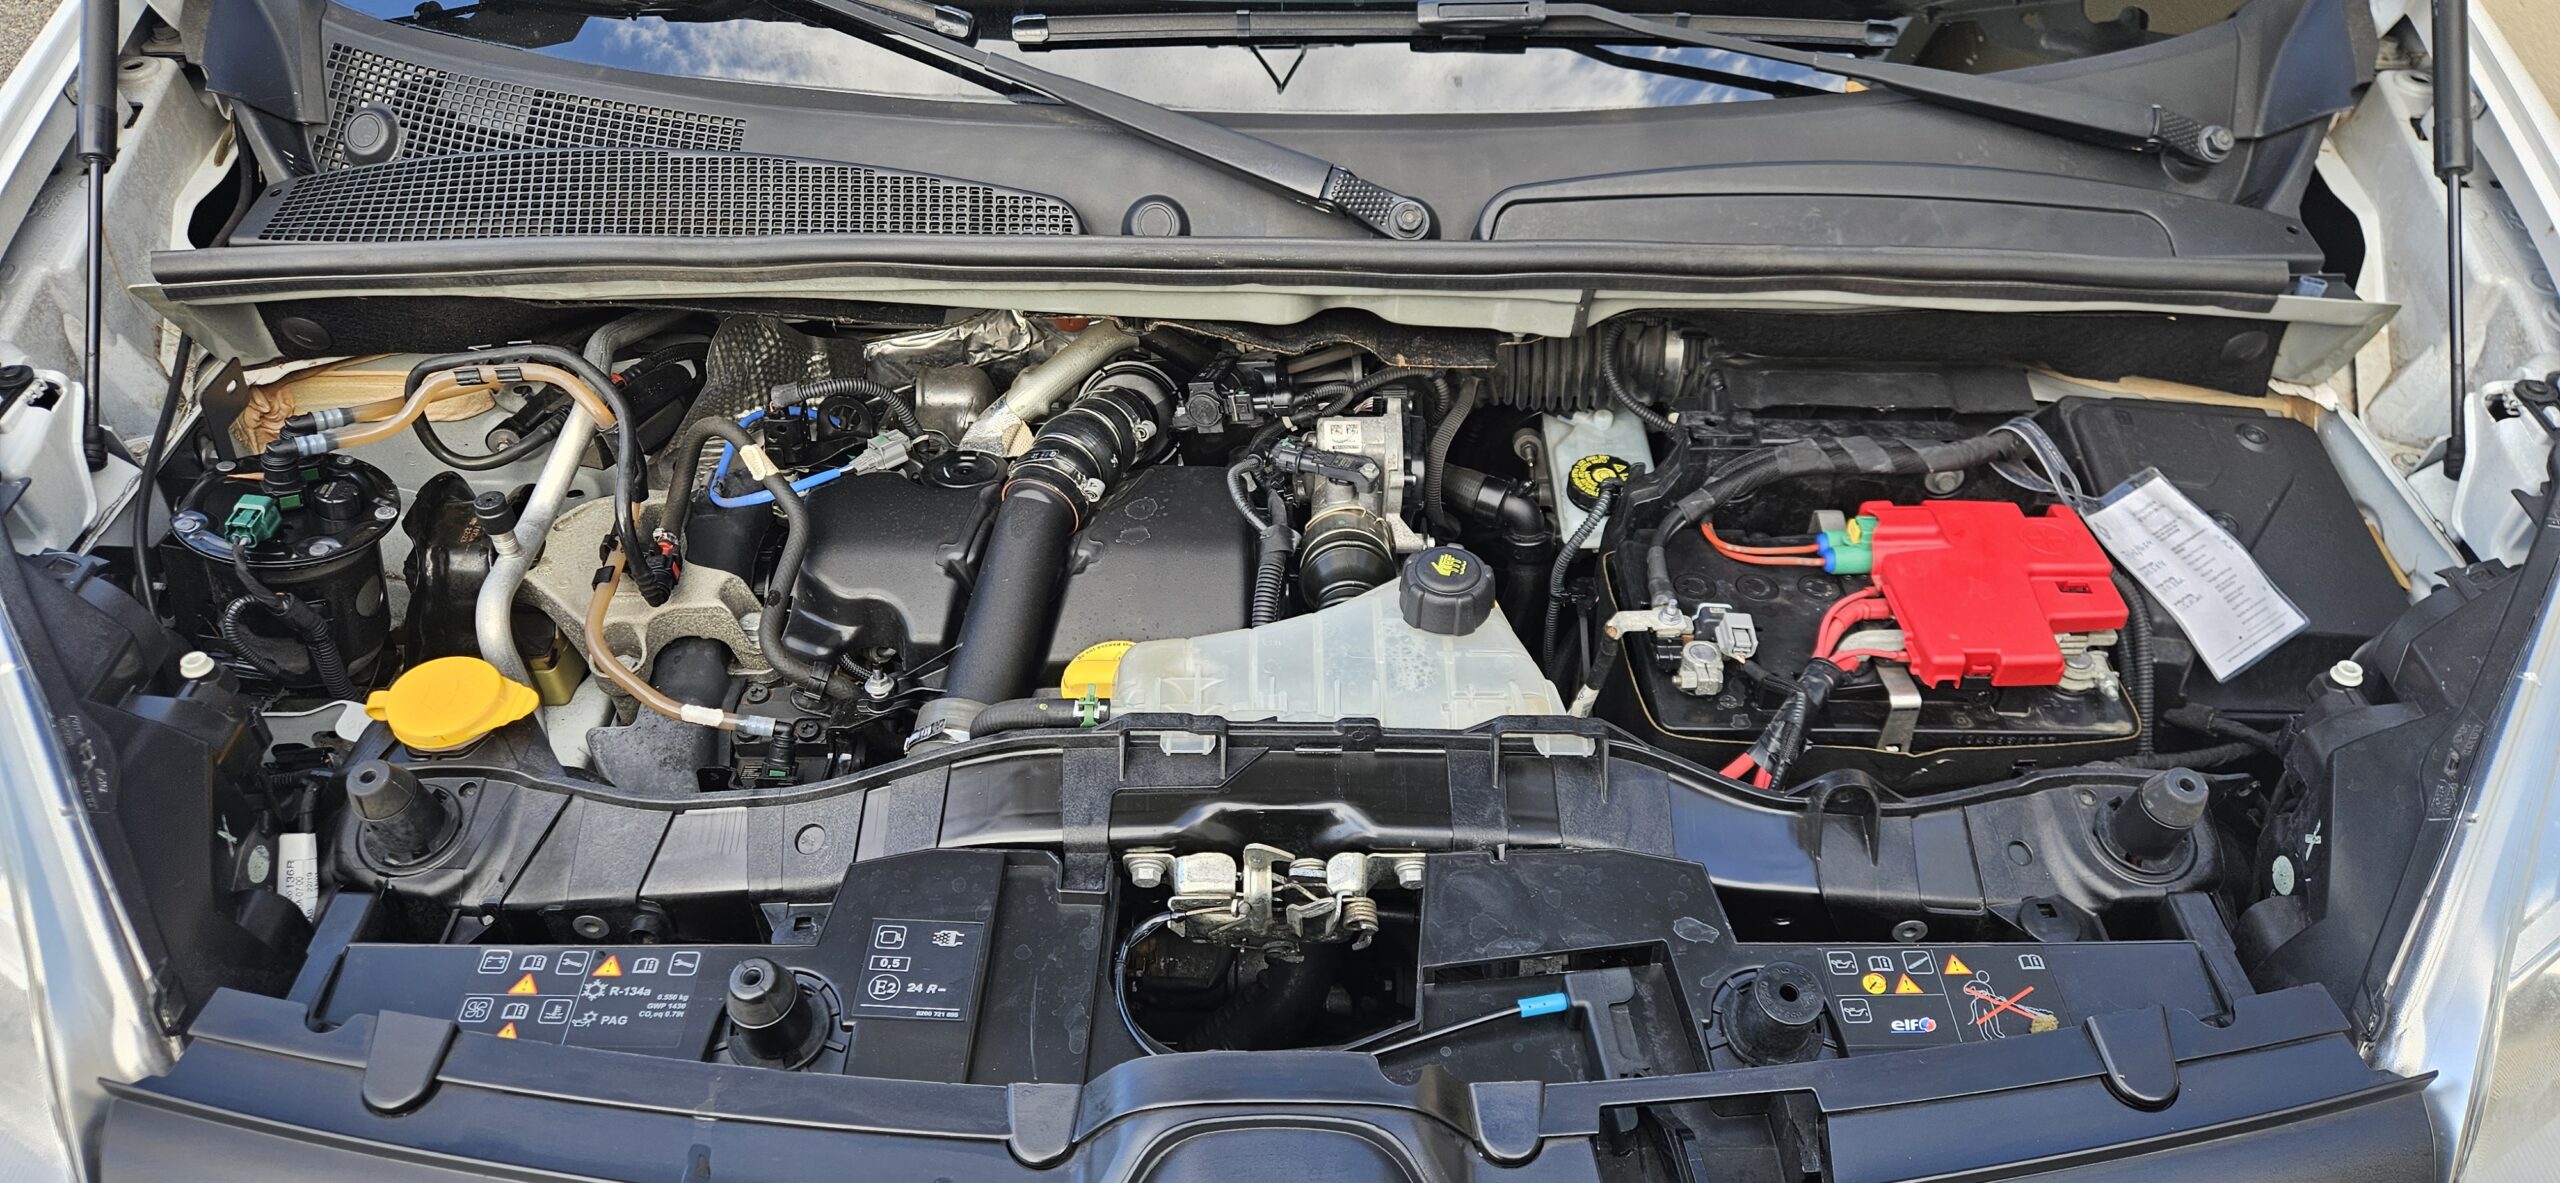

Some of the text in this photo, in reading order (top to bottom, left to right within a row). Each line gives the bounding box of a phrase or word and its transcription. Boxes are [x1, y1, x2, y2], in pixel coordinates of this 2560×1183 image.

[286, 860, 294, 888] 136R
[880, 958, 900, 968] 0,5
[610, 986, 652, 996] R-134a
[873, 980, 896, 994] E2
[906, 983, 923, 992] 24
[600, 1016, 628, 1025] PAG
[1891, 1019, 1918, 1030] elf
